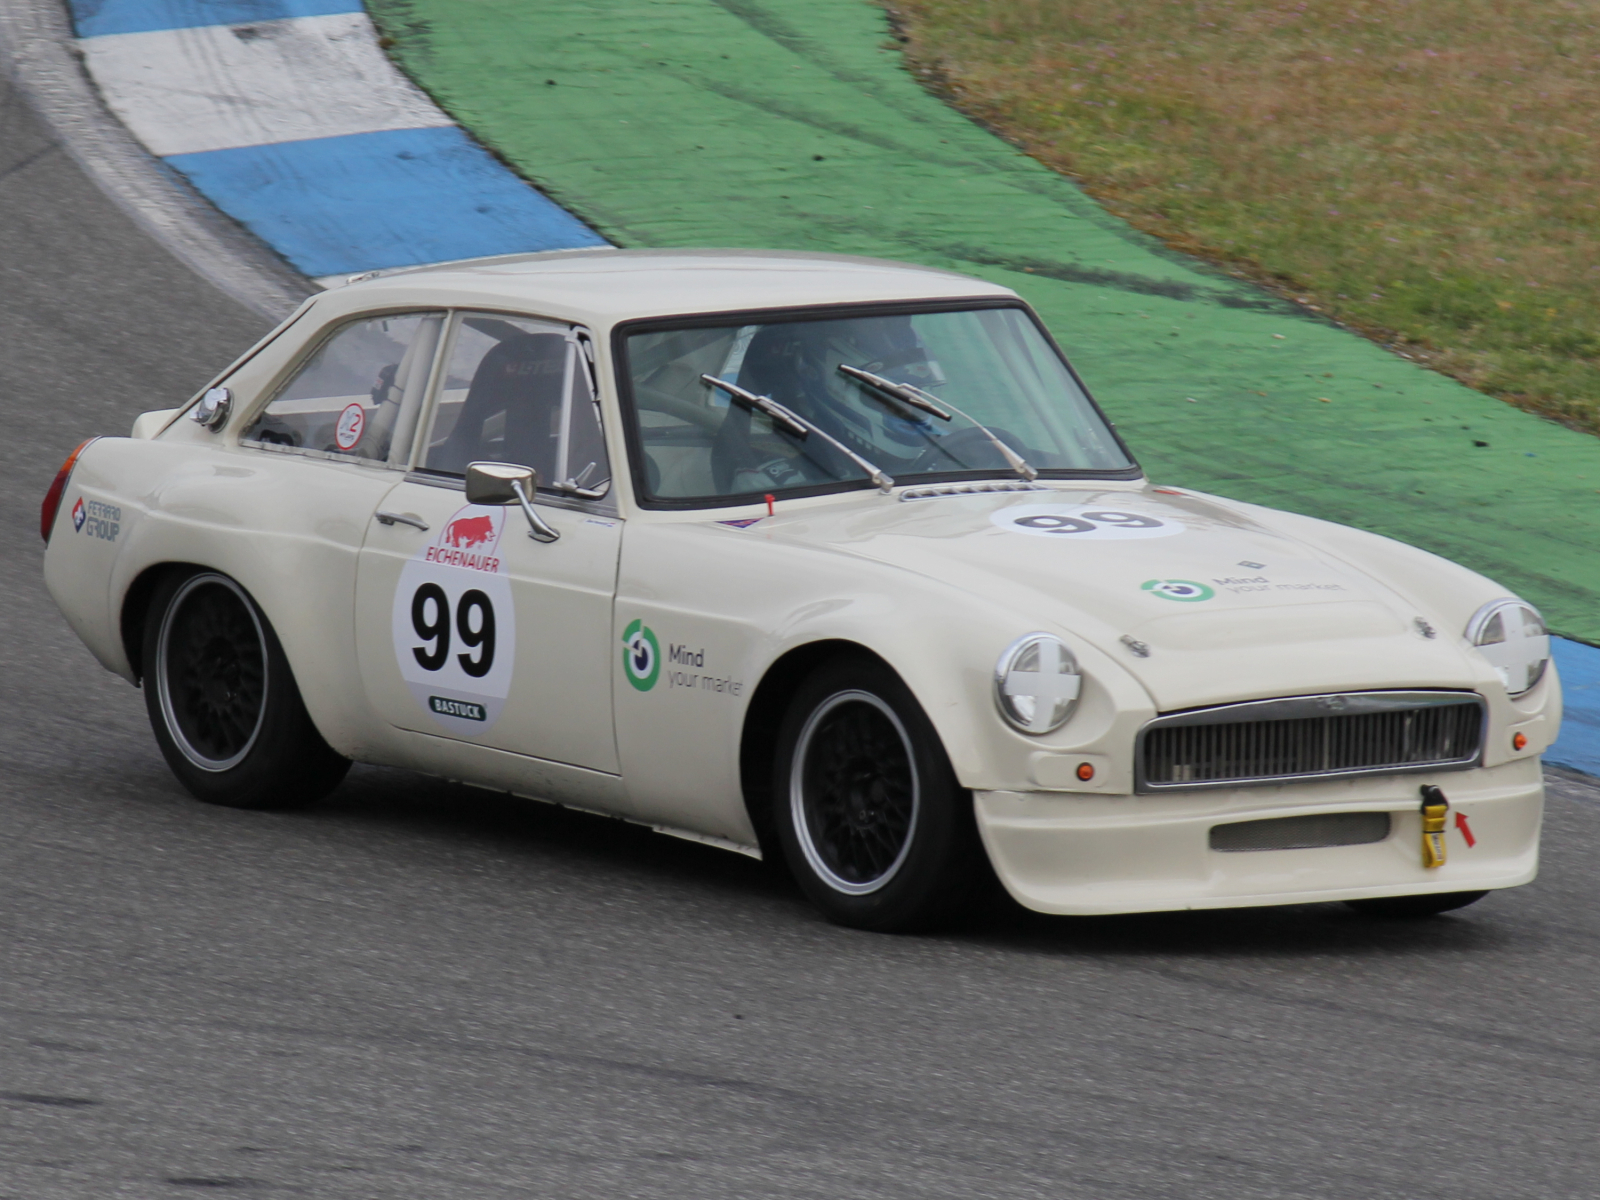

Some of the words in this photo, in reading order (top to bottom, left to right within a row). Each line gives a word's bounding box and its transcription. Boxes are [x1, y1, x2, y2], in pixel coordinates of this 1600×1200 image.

[86, 516, 120, 542] GROUP
[1013, 511, 1165, 534] 99
[425, 546, 500, 573] EICHENAUER
[1212, 576, 1270, 586] Mind
[1225, 583, 1272, 595] your
[411, 582, 496, 678] 99
[668, 643, 705, 667] Mind
[667, 670, 699, 688] your
[433, 698, 481, 719] BASTUCK
